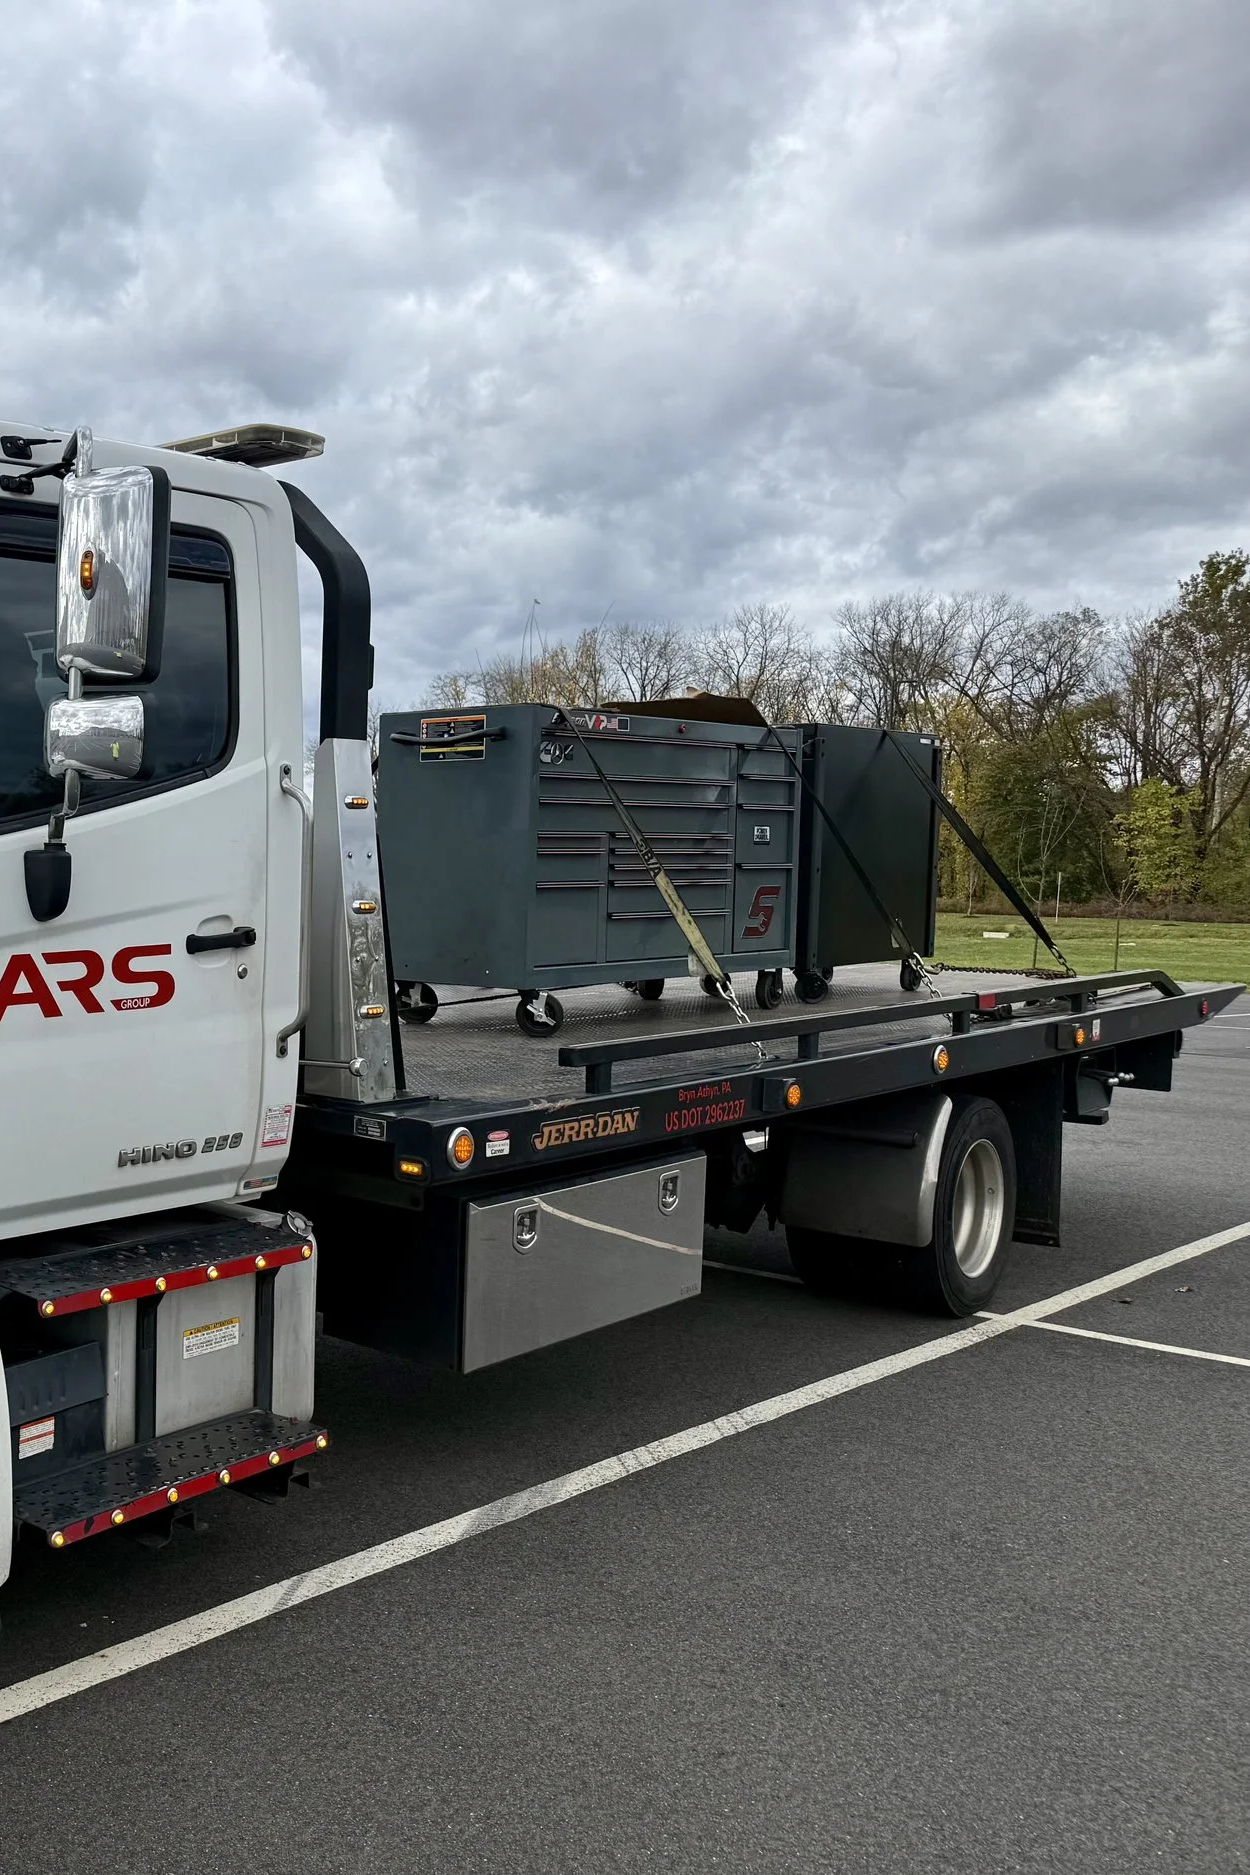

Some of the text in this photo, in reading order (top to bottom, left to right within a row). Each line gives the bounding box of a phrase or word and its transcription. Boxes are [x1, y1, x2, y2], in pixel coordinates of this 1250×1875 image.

[121, 998, 151, 1010] GROUP
[678, 1089, 696, 1103] Bryn
[721, 1081, 732, 1094] PA
[665, 1099, 745, 1132] US DOT 2962237
[117, 1132, 244, 1168] HINO 258
